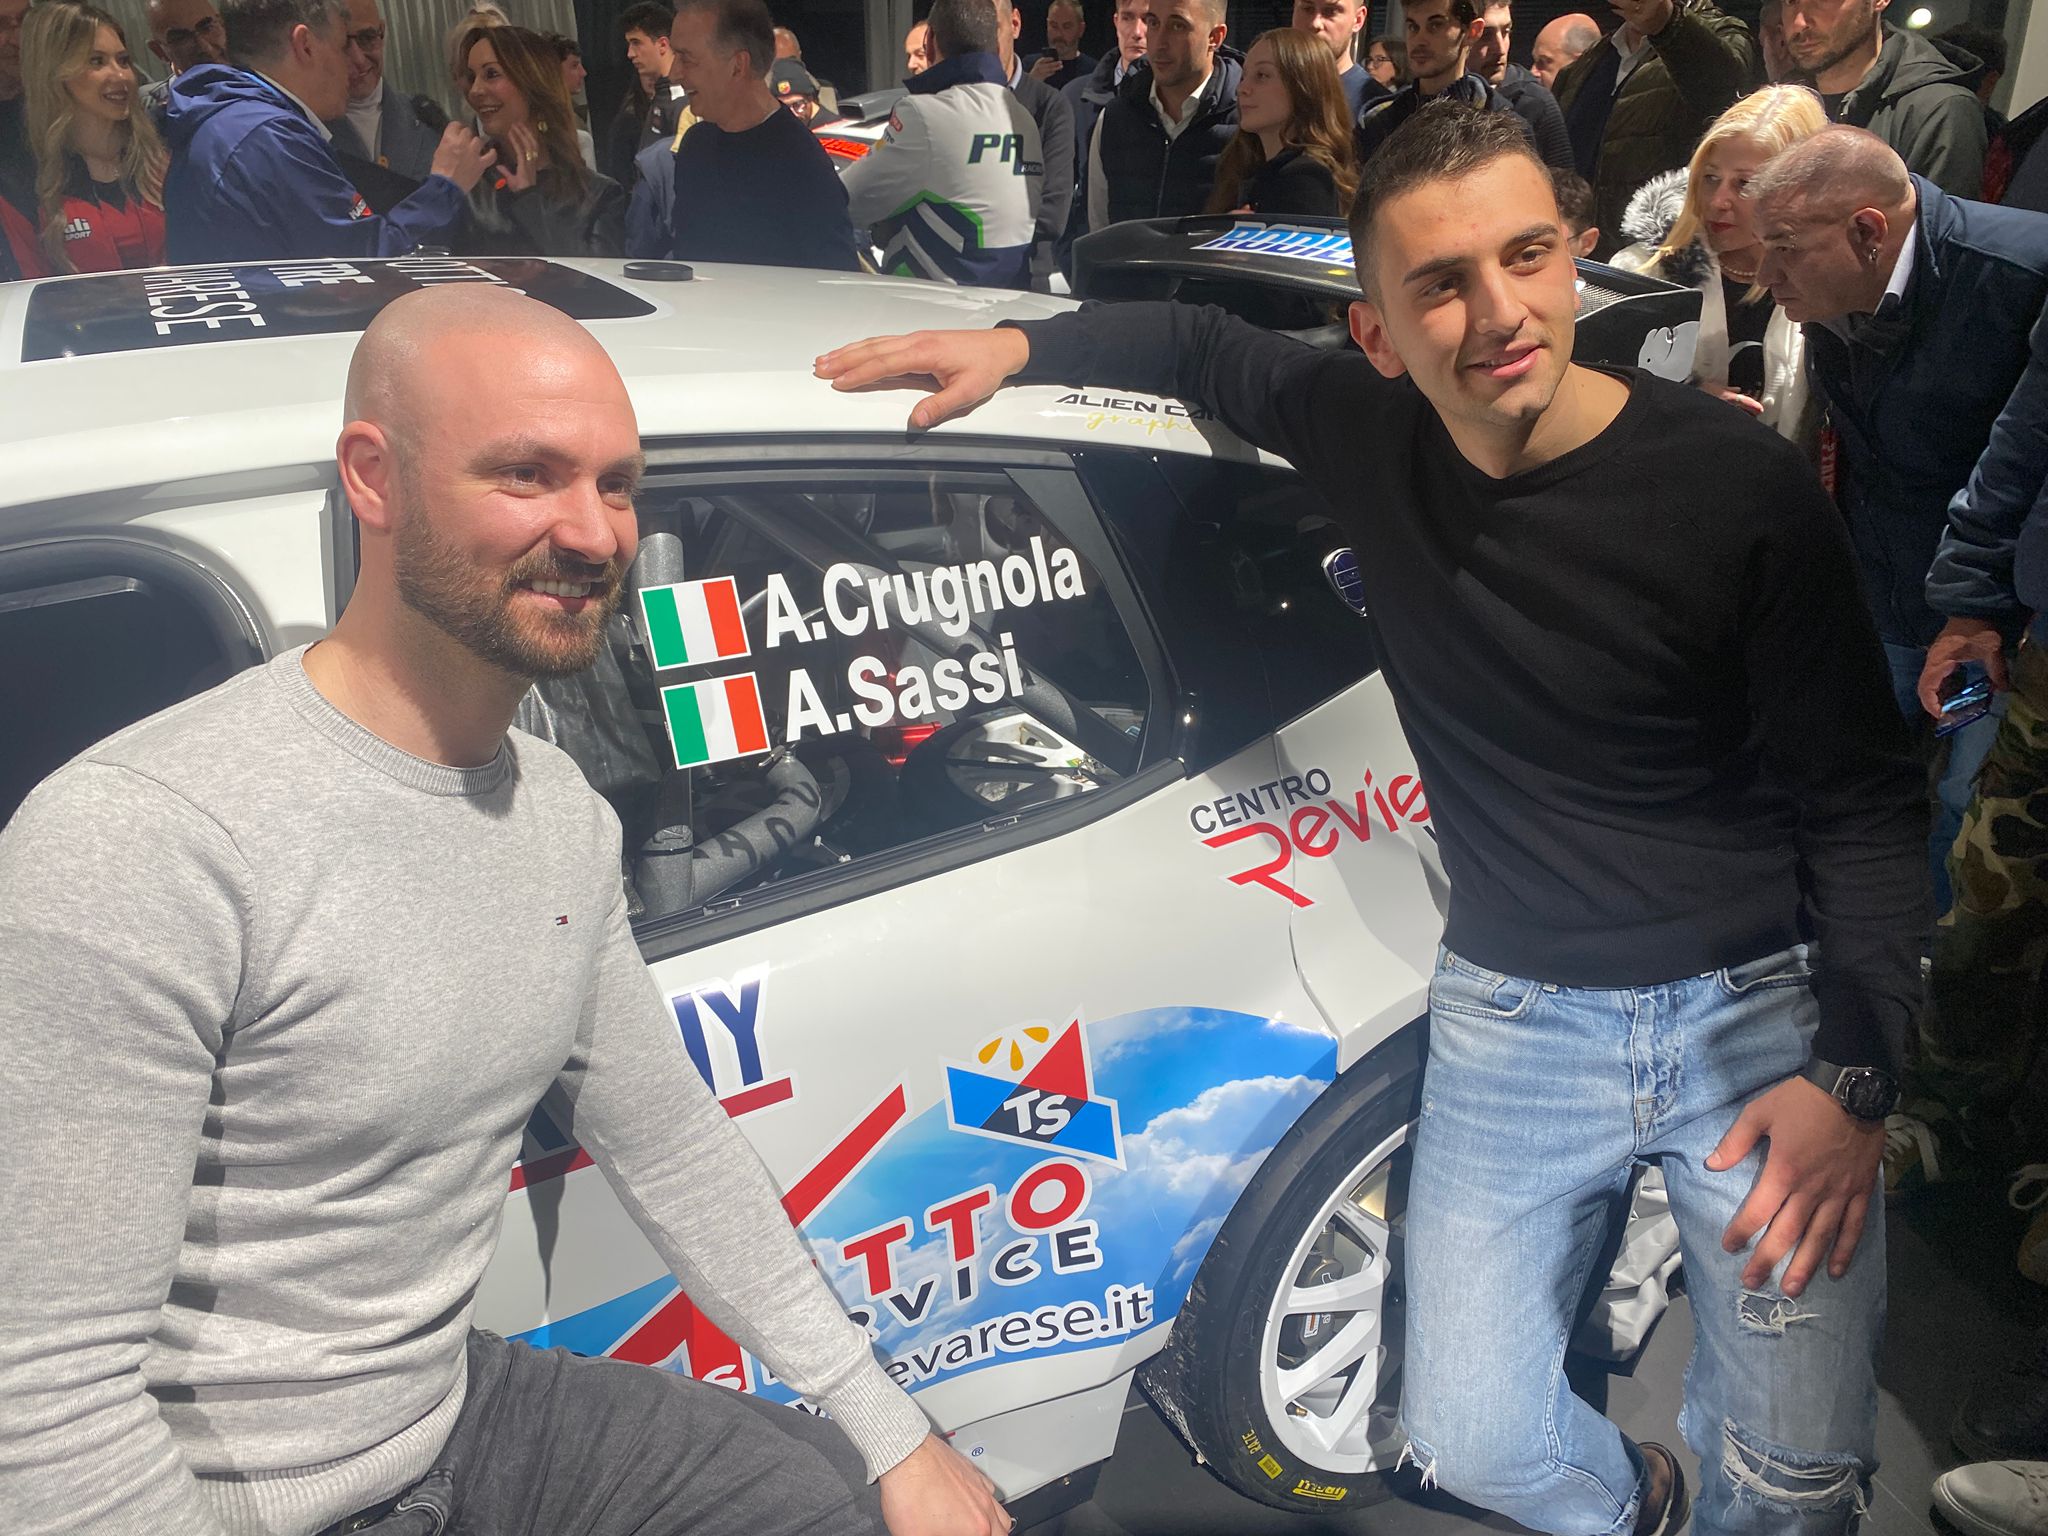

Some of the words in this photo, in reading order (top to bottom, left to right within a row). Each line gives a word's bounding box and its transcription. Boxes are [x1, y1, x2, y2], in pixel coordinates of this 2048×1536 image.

[142, 268, 266, 335] VARESE
[268, 262, 376, 287] TRE
[386, 259, 526, 295] OTTI
[1055, 393, 1157, 414] ALIEN
[766, 535, 1086, 649] A.Crugnola
[786, 631, 1024, 743] A.Sassi
[1190, 768, 1331, 834] CENTRO
[1003, 1089, 1071, 1136] TS
[843, 1163, 1086, 1297] TTO
